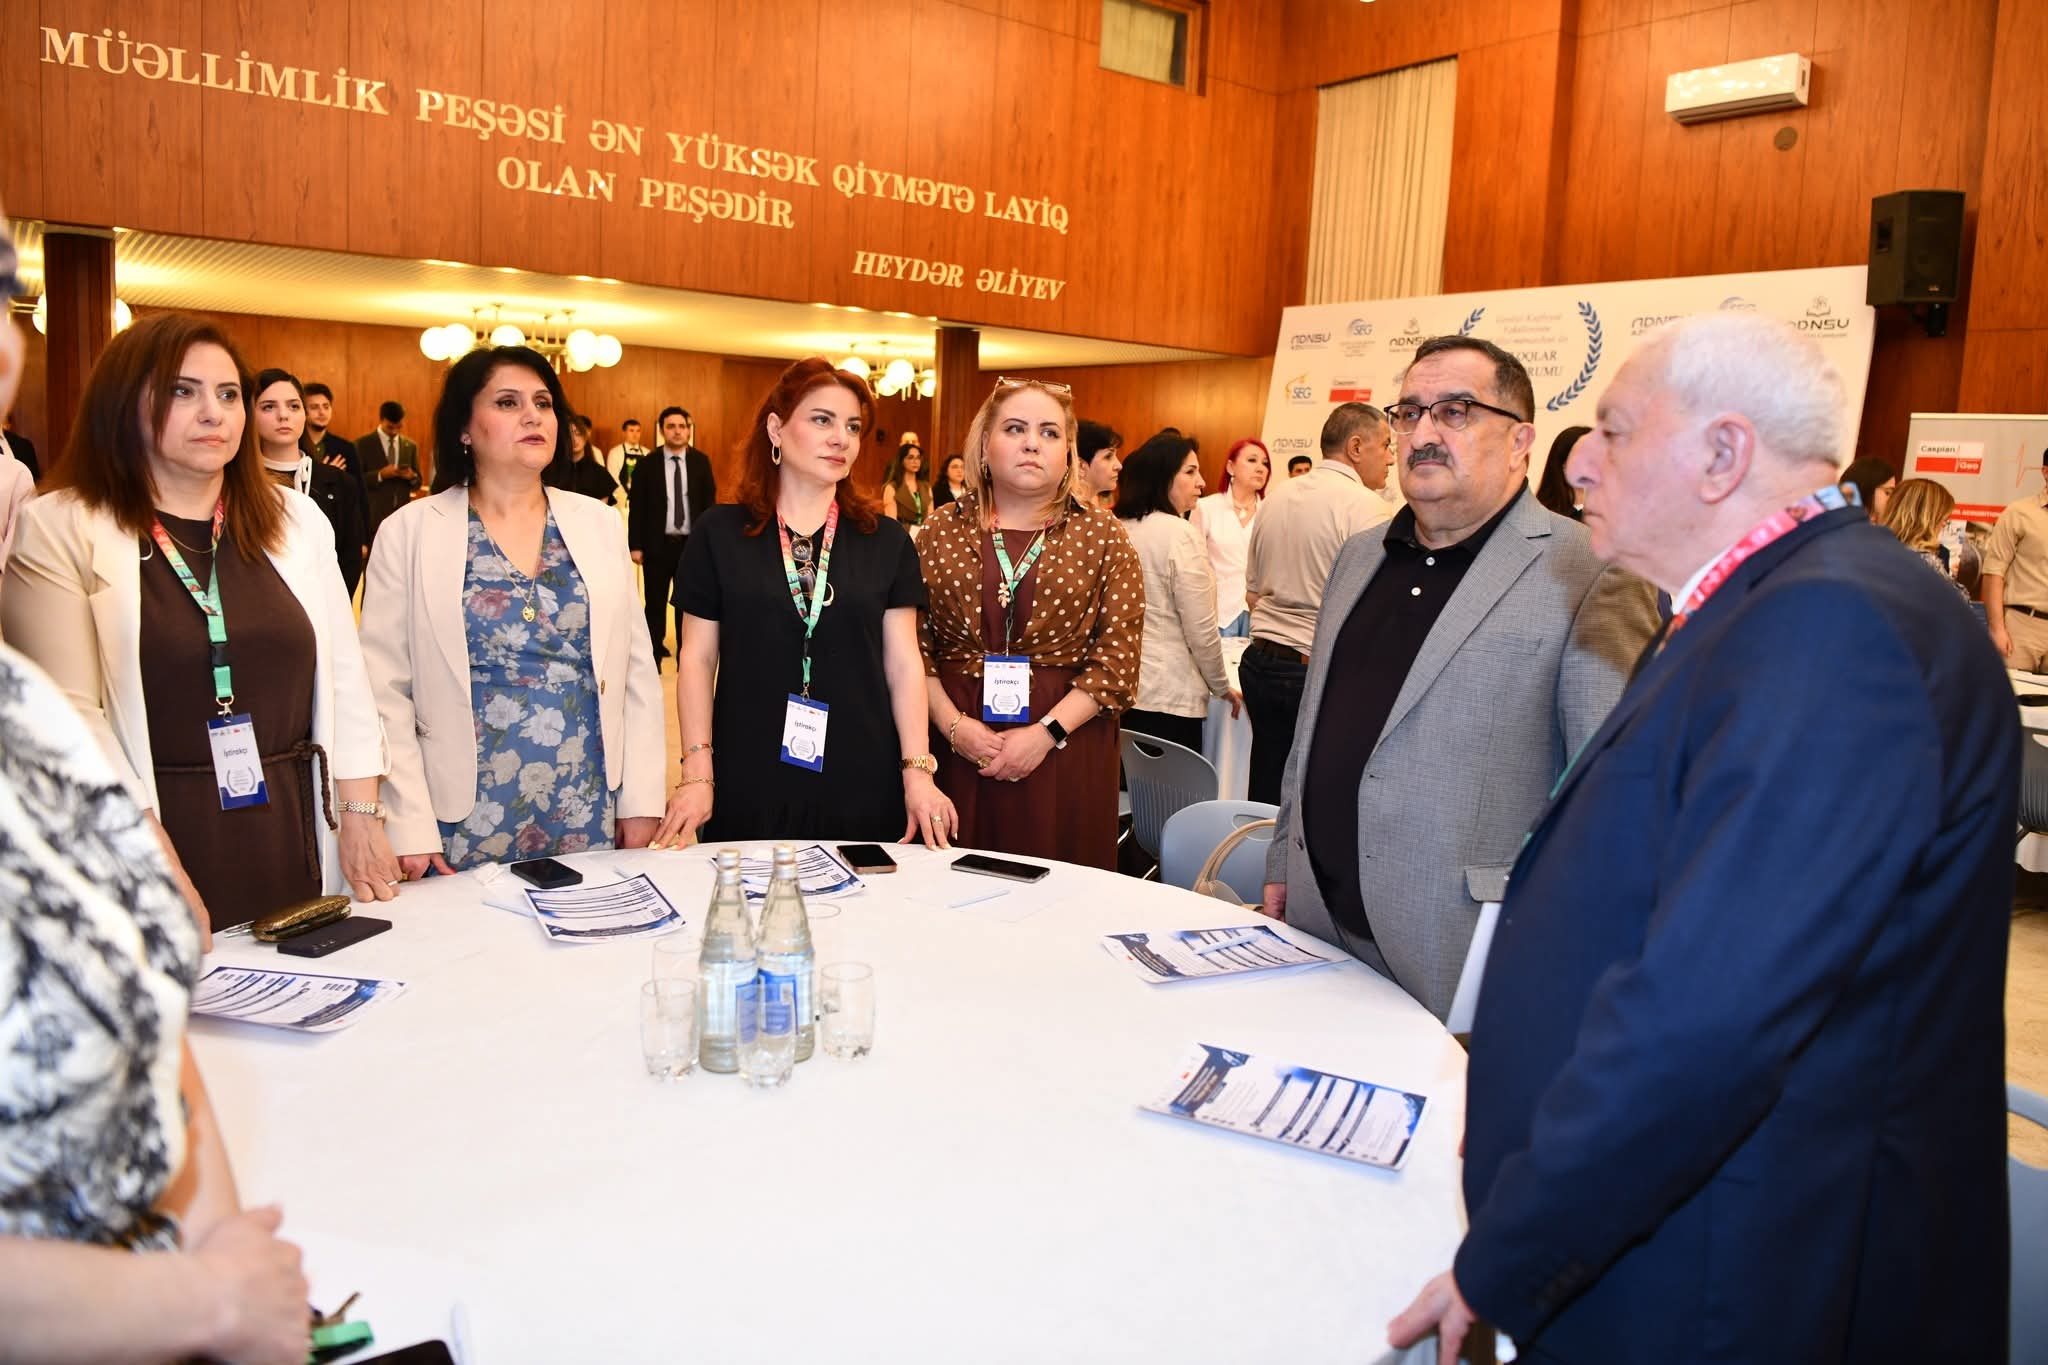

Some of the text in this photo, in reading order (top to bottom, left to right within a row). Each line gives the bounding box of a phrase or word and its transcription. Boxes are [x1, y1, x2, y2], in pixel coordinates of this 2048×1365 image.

[40, 26, 1069, 235] MÜƏLLİMLİK PEŞƏSİ ƏN YÜKSƏK QİYMƏTƏ LAYİQ
[497, 156, 795, 229] OLAN PEŞƏDİR
[852, 251, 1066, 301] HEYDƏR ƏLİYEV
